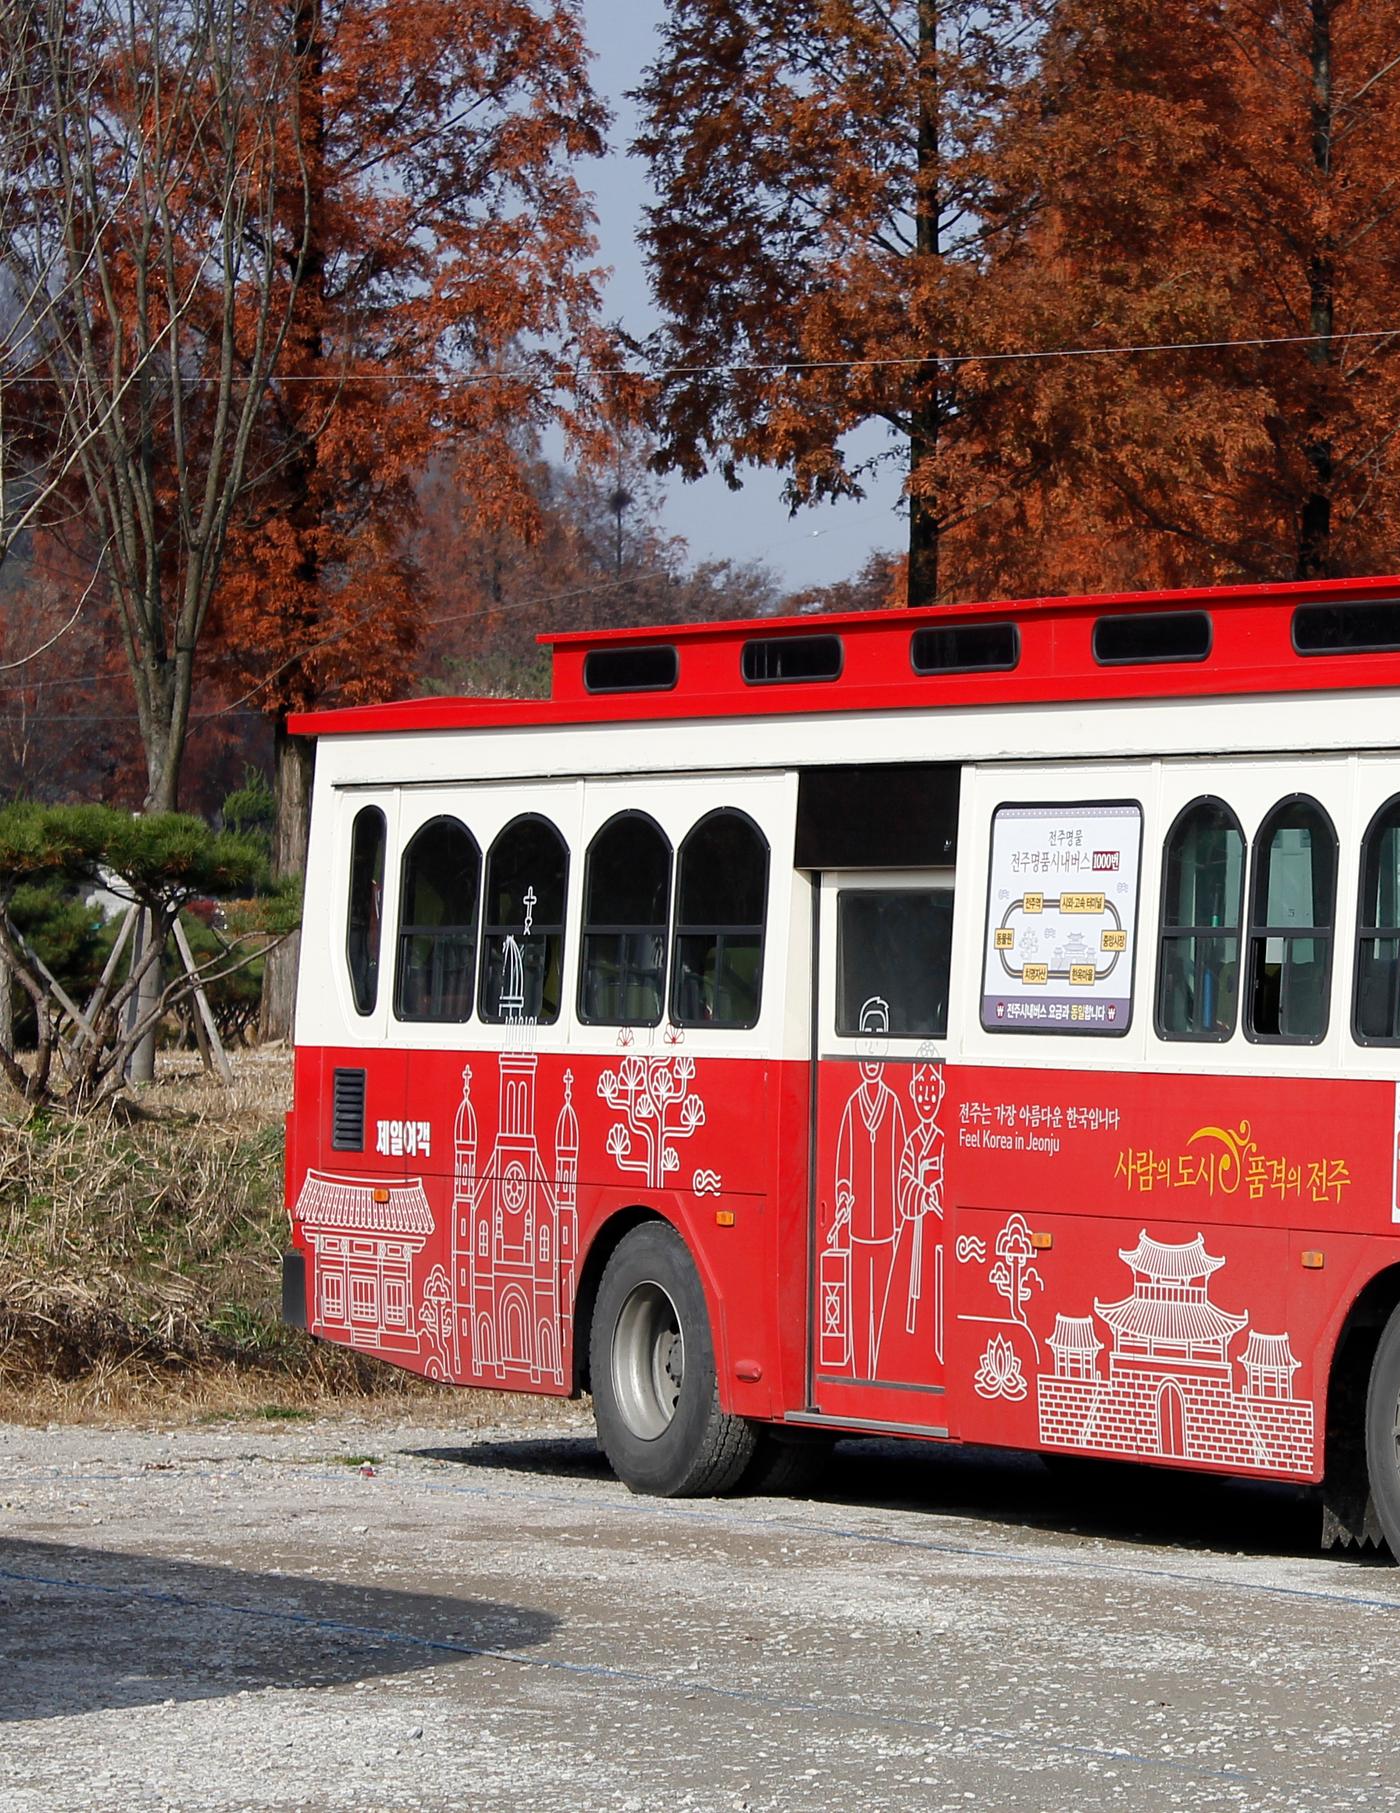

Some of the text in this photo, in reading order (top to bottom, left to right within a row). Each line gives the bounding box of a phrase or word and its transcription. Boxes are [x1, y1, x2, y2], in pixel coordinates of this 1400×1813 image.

[1049, 829, 1083, 847] 전주명물
[1011, 851, 1120, 873] 전주명품시내버스 1000번
[1007, 1002, 1047, 1019] 전주시내버스
[1047, 1004, 1069, 1020] 요금과
[1071, 1004, 1106, 1021] 동일합니다
[959, 1102, 1120, 1131] 전주는 가장 아름다운 한국입니다
[376, 1120, 430, 1157] 제일여객
[959, 1128, 1060, 1157] Feel Korea in Jeonju
[1114, 1147, 1351, 1205] 사람의 도시 품격의 전주
